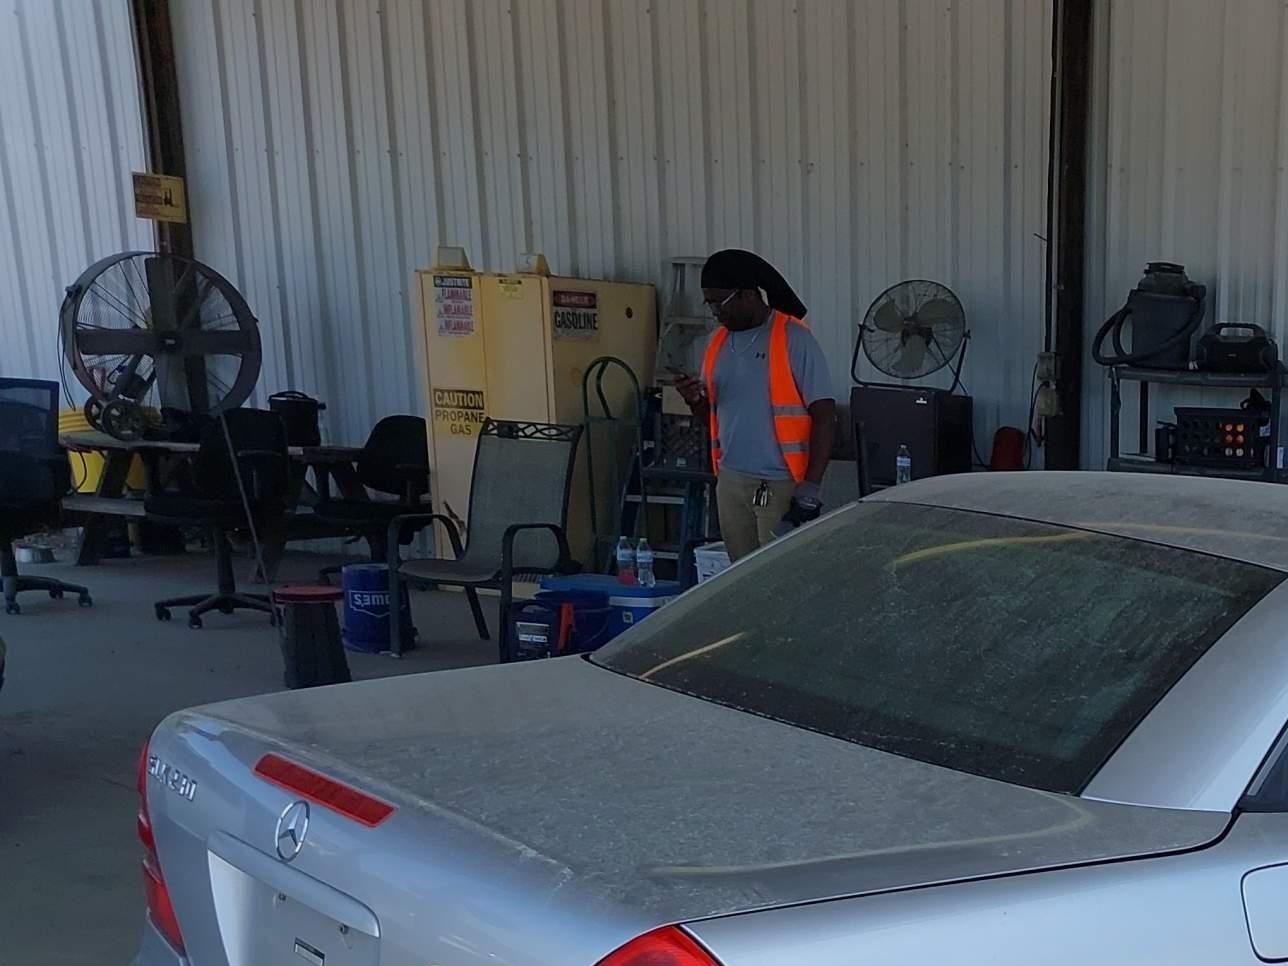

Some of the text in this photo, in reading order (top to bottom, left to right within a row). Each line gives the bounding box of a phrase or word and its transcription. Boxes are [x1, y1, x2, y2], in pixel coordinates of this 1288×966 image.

[554, 311, 598, 330] GASOLINE
[435, 391, 484, 408] CAUTION
[435, 409, 485, 423] PROPANE
[451, 423, 472, 436] GAS
